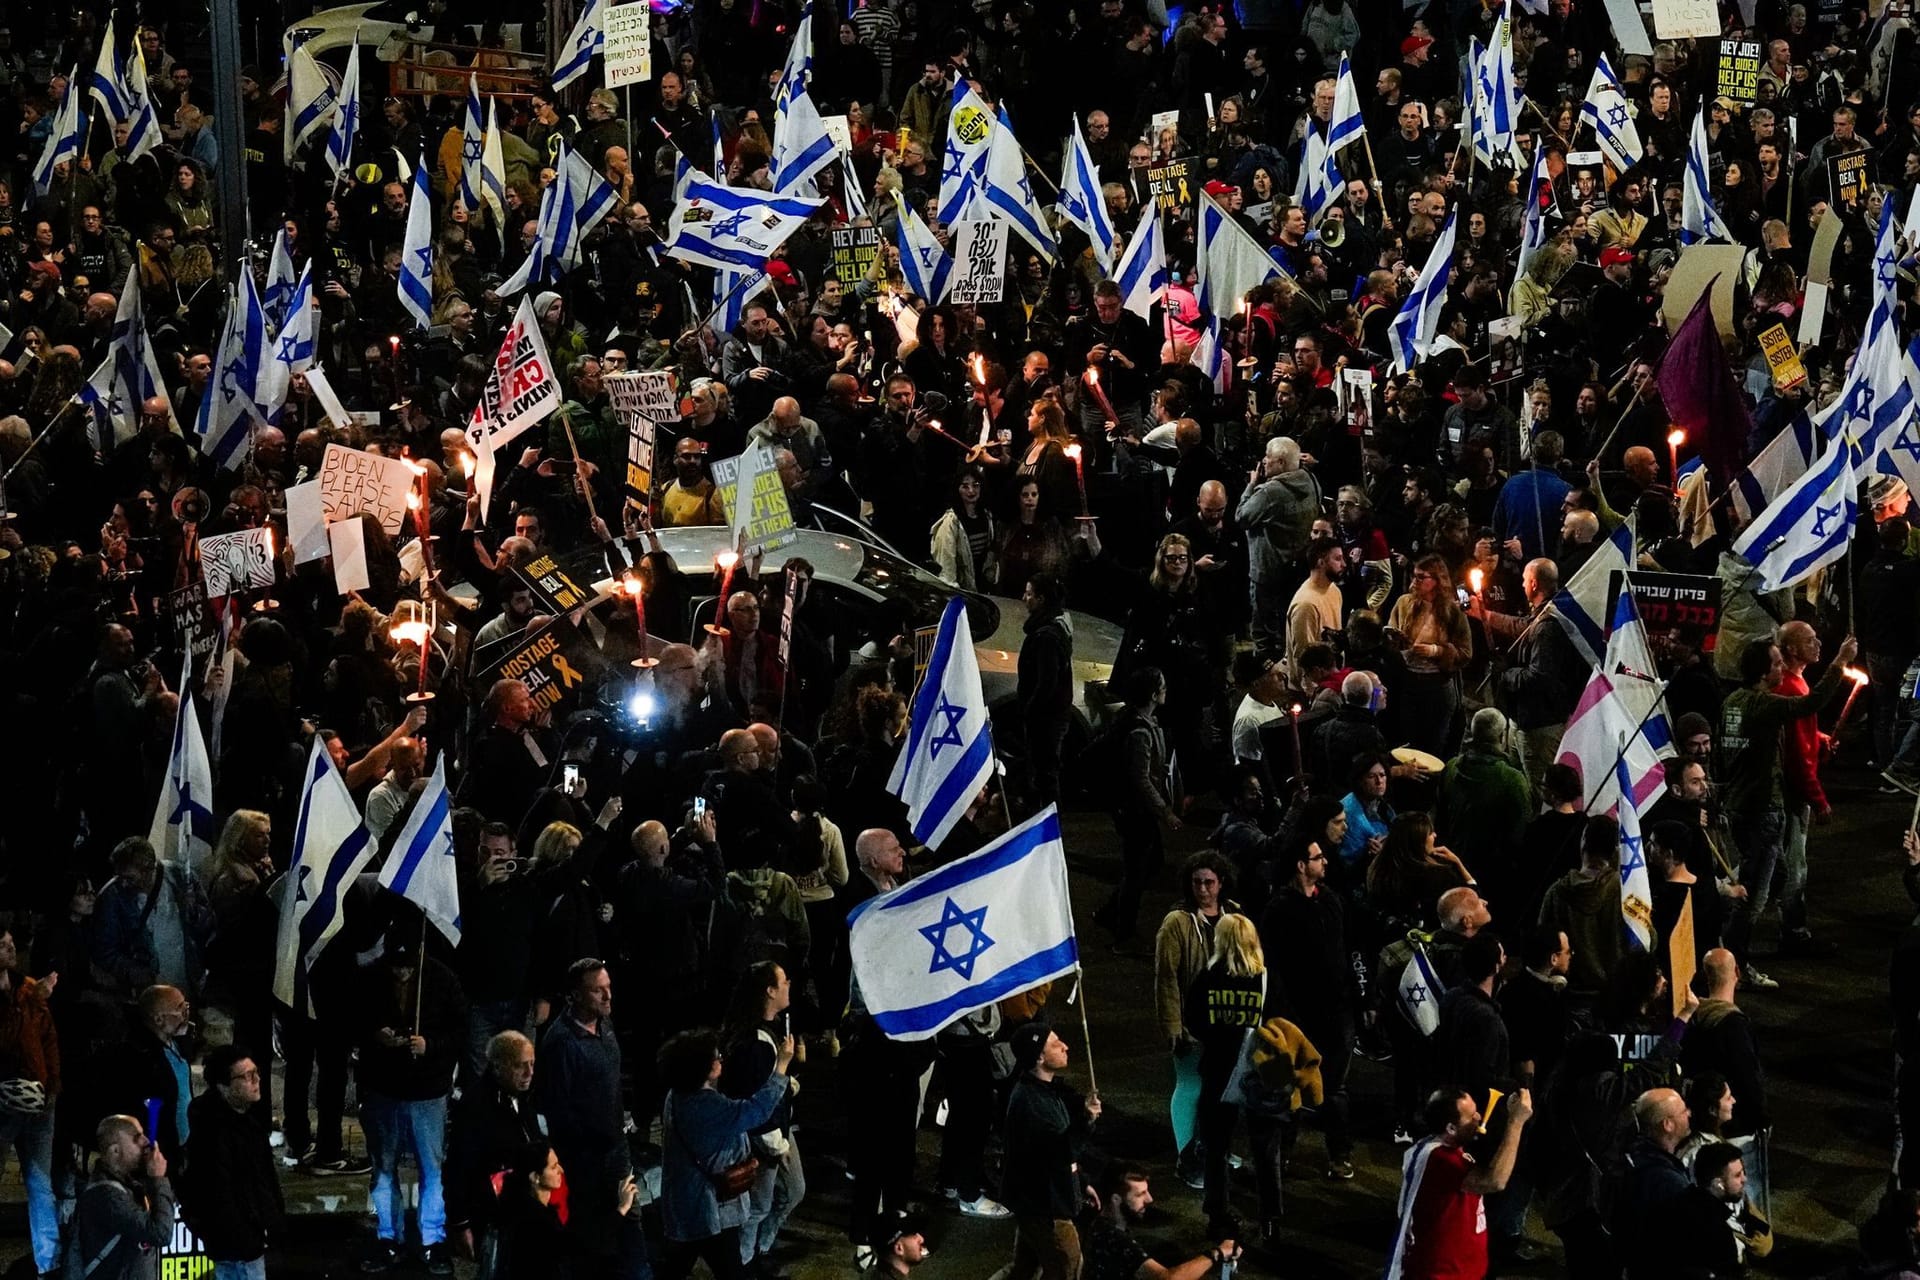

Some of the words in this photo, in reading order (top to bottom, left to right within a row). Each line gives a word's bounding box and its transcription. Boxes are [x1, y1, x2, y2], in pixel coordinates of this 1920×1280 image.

[1720, 40, 1738, 55] HEY
[1738, 43, 1760, 58] JOE!
[1719, 56, 1734, 69] MR.
[1735, 58, 1758, 71] BIDEN
[1718, 69, 1743, 86] HELP
[1743, 72, 1757, 88] US
[1717, 85, 1735, 97] SAVE
[1735, 87, 1756, 100] THEM!
[1147, 163, 1188, 182] HOSTAGE
[1837, 154, 1867, 172] HOSTAGE
[1149, 179, 1175, 195] DEAL
[1839, 170, 1857, 186] DEAL
[1840, 185, 1858, 201] NOW
[832, 229, 855, 248] HEY
[834, 248, 854, 265] MR.
[855, 246, 878, 262] BIDE
[835, 262, 868, 283] HELP
[1761, 327, 1786, 349] SISTER
[1769, 345, 1794, 367] SISTER
[326, 448, 386, 483] BIDEN
[321, 470, 393, 509] PLEASE
[764, 492, 788, 517] US
[524, 554, 559, 580] HOSTAGE
[539, 574, 563, 594] DEAL
[1673, 587, 1707, 601] פדיון
[554, 588, 579, 610] NOW
[175, 603, 203, 631] HAS
[500, 632, 561, 680] HOSTAGE
[520, 667, 551, 693] EAL
[1208, 988, 1263, 1009] הדחה
